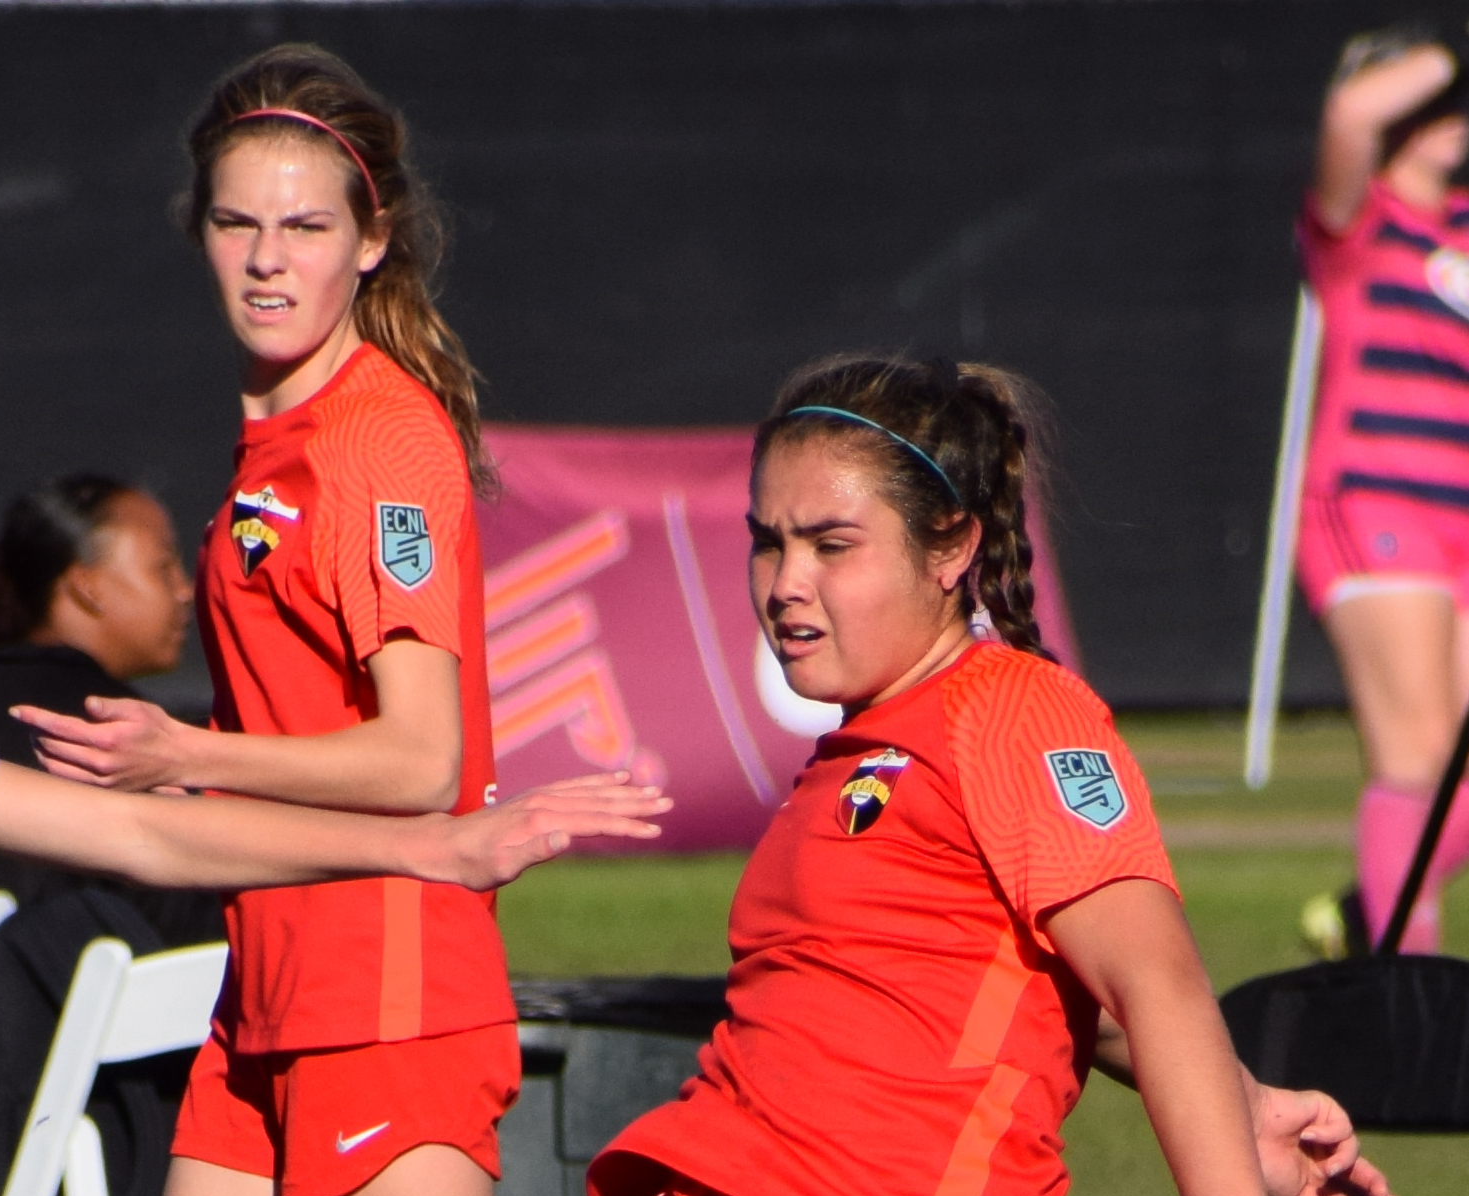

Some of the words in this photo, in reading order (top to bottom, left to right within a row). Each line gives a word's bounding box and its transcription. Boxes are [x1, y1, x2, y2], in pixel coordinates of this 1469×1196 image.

[382, 507, 429, 535] ECNL
[1051, 752, 1113, 779] ECNL
[851, 780, 882, 794] REAL
